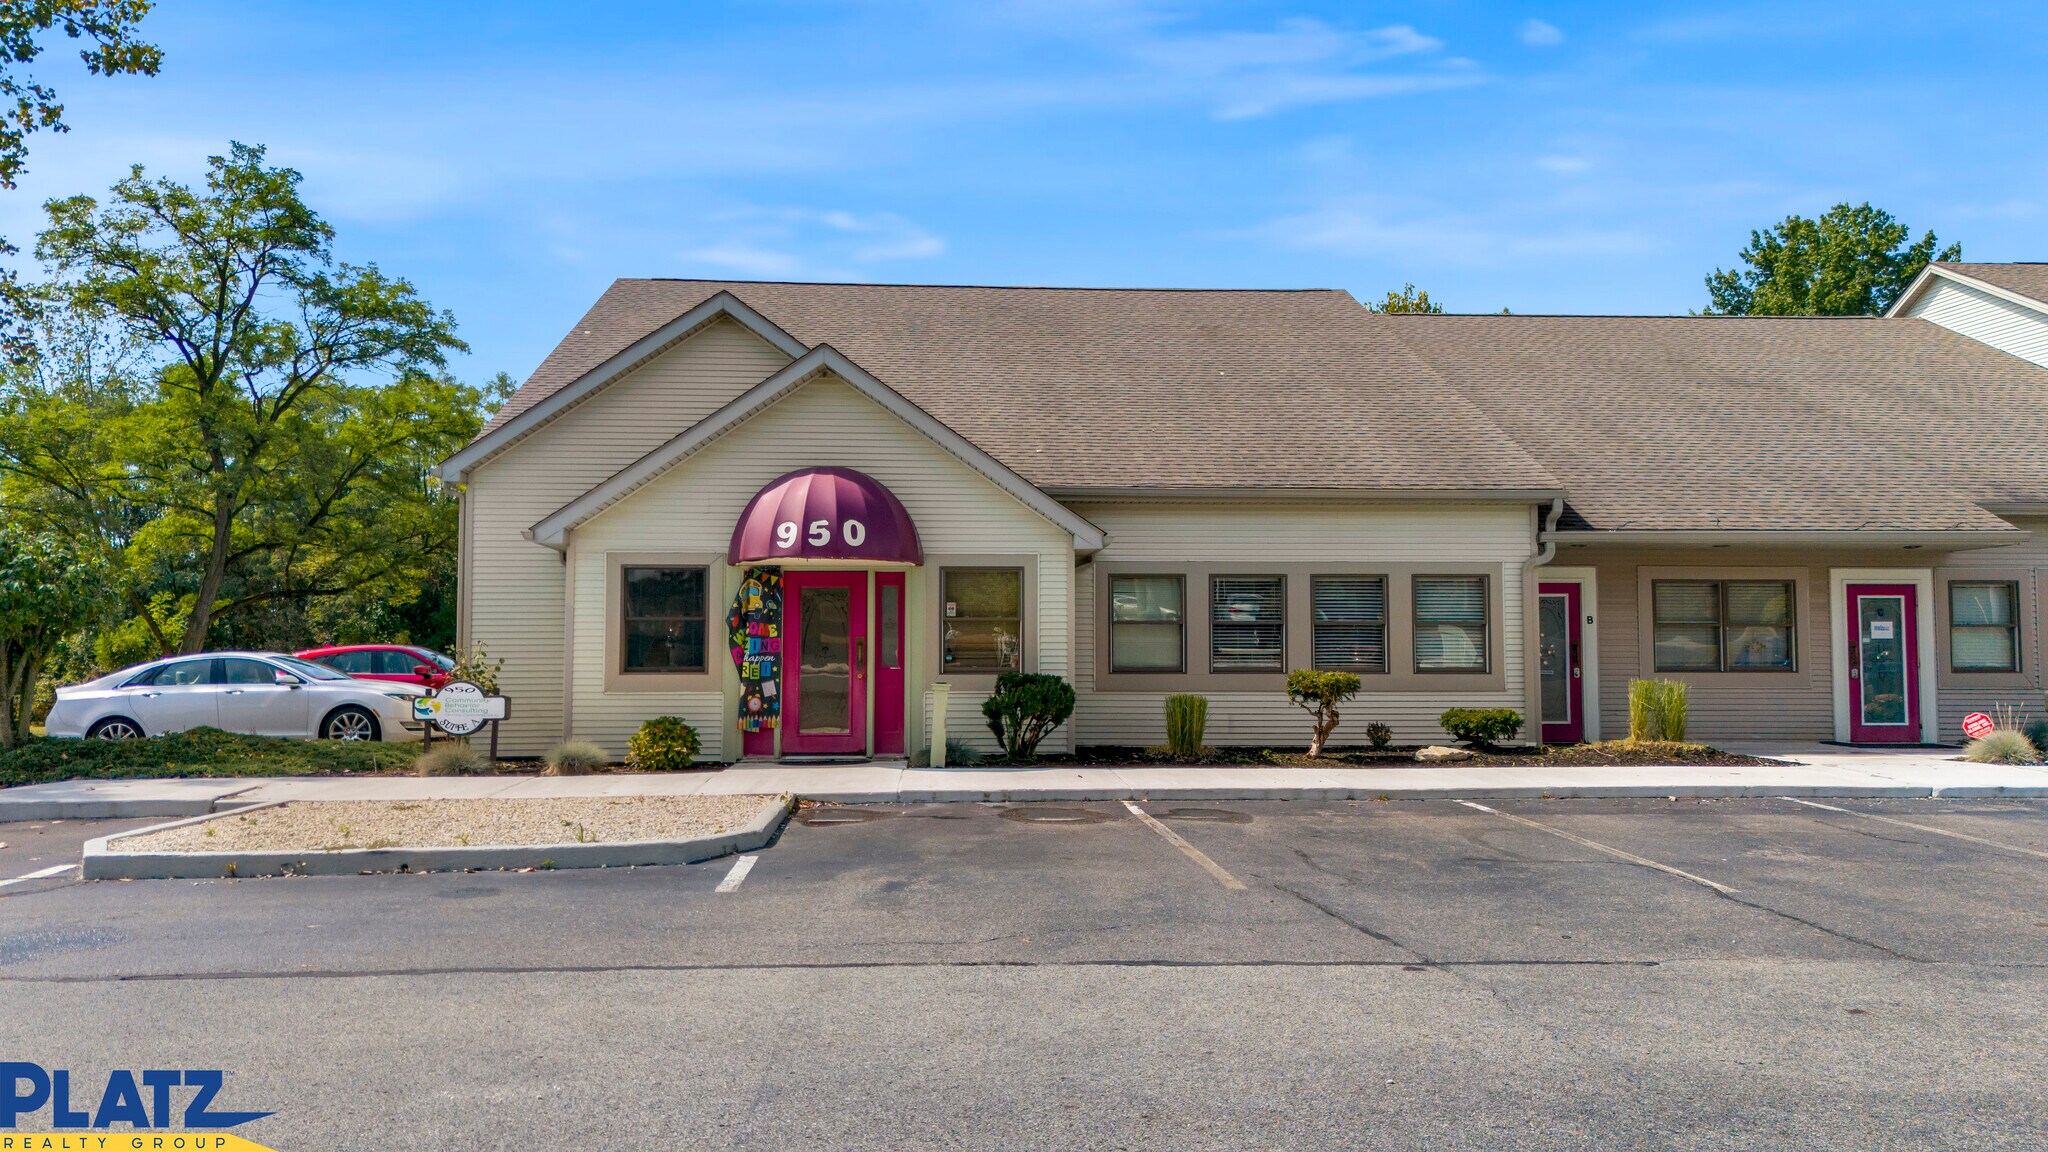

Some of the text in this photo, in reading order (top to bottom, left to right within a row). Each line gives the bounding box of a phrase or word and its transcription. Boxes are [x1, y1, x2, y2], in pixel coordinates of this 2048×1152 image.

[776, 519, 866, 549] 950
[1586, 616, 1594, 624] B
[743, 652, 776, 665] happen
[439, 719, 480, 731] SUITE A
